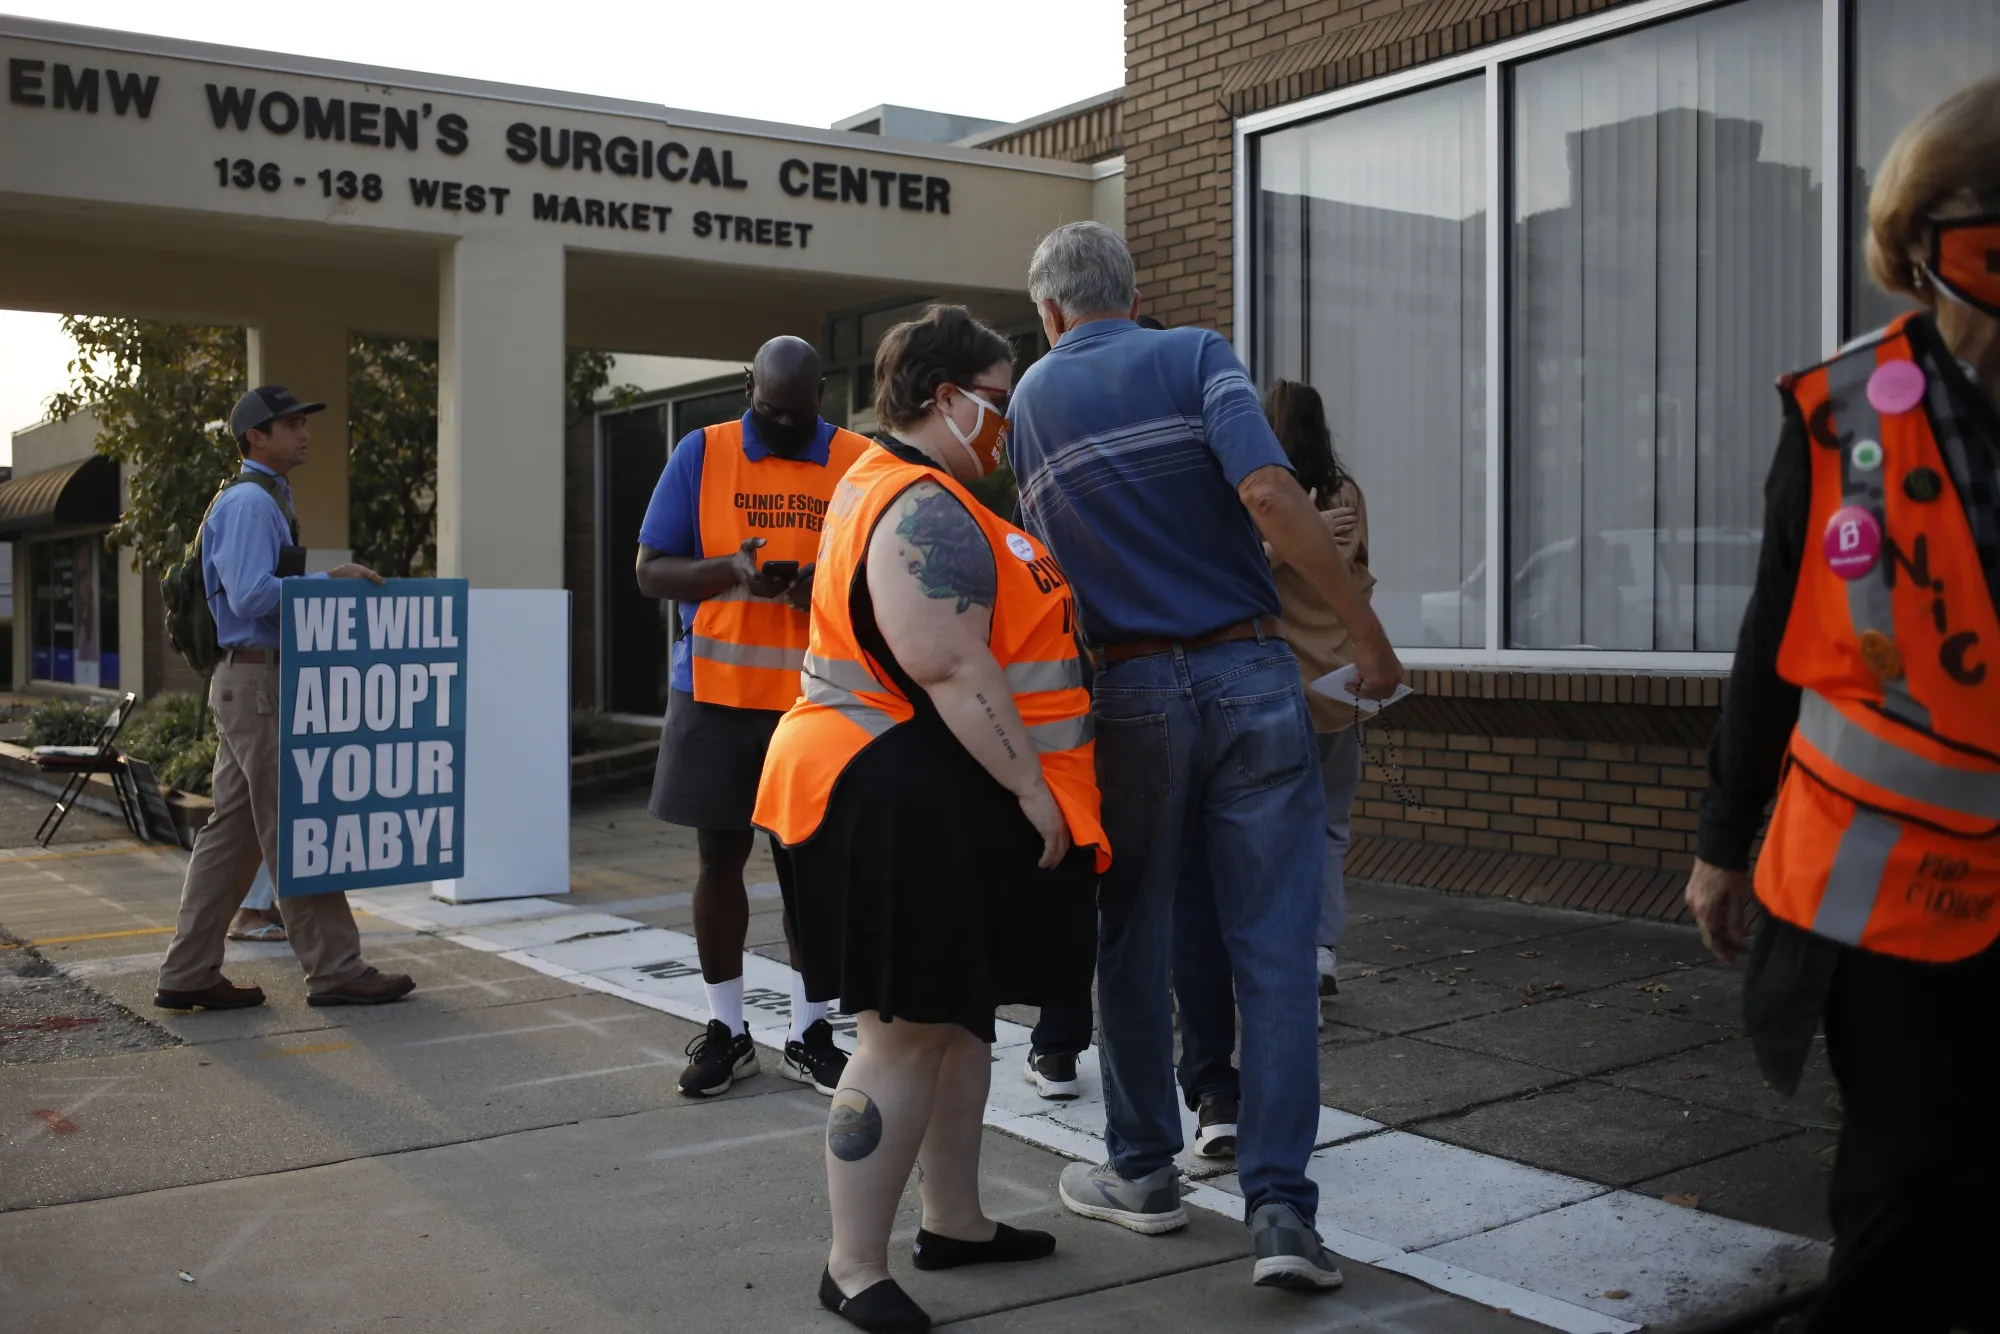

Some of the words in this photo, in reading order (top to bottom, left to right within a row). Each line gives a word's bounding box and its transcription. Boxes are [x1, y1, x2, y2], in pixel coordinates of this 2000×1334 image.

[8, 57, 160, 120] EMW
[204, 82, 469, 157] WOMEN'S
[505, 122, 748, 191] SURGICAL
[778, 158, 951, 216] CENTER
[213, 157, 282, 194] 136
[317, 168, 384, 203] 138
[408, 177, 511, 216] WEST
[532, 192, 673, 233] MARKET
[692, 210, 814, 249] STREET
[734, 492, 785, 511] CLINIC
[788, 493, 831, 516] ESCO
[293, 596, 357, 652] WE
[365, 595, 459, 650] WILL
[292, 661, 458, 735] ADOPT
[291, 740, 454, 805] YOUR
[292, 805, 455, 879] BABY!
